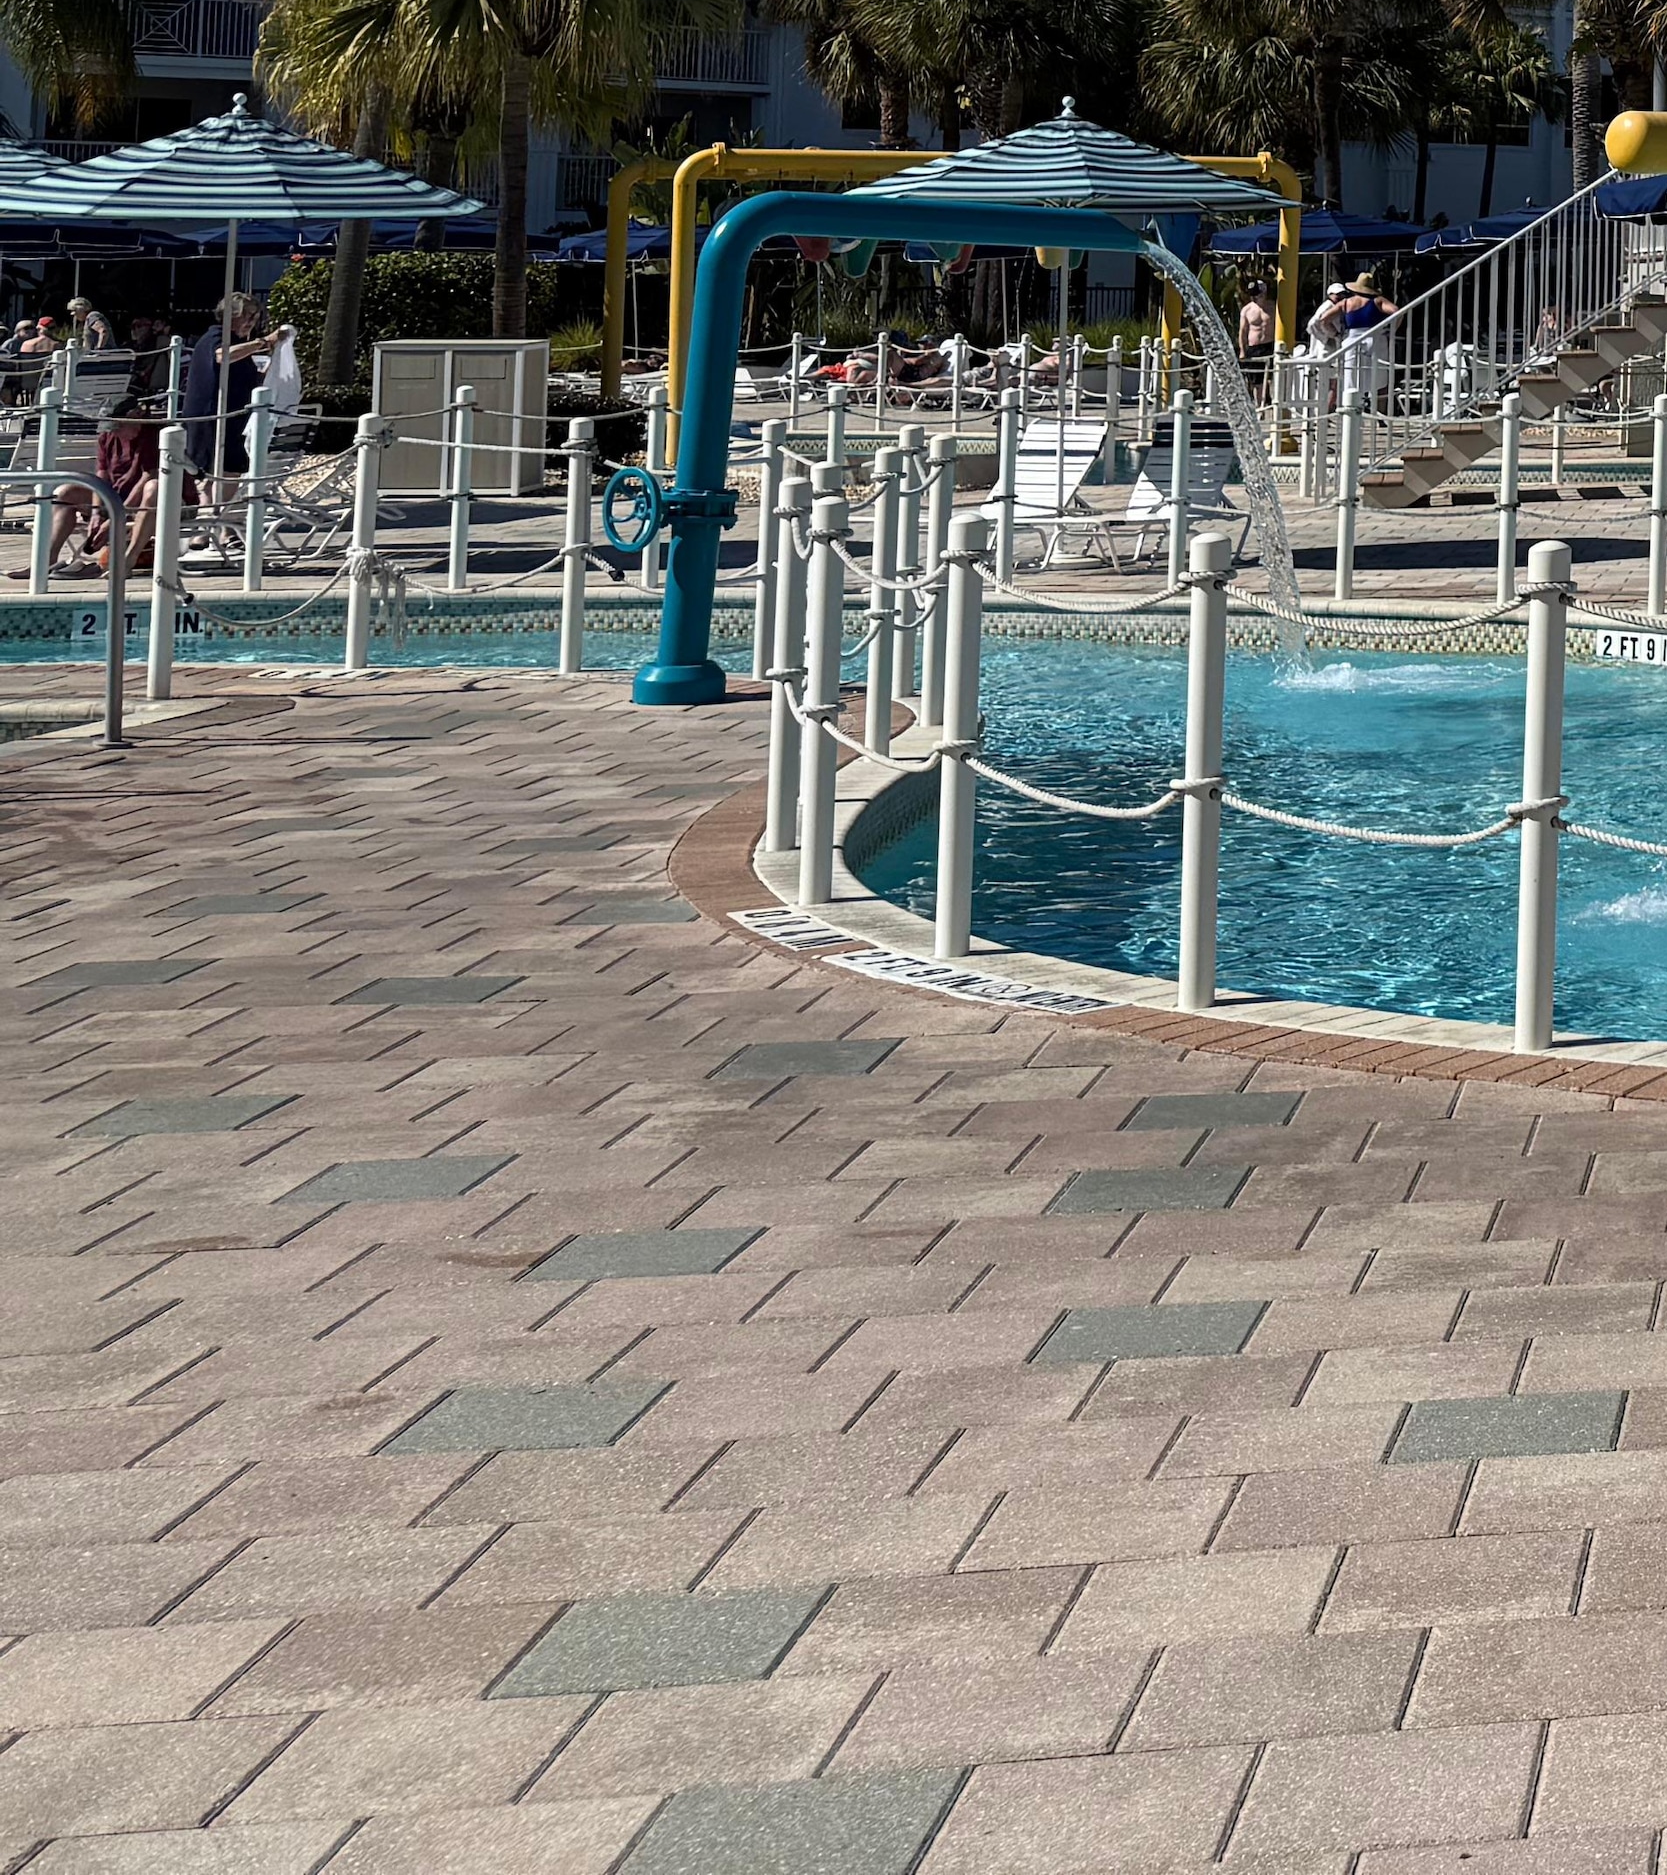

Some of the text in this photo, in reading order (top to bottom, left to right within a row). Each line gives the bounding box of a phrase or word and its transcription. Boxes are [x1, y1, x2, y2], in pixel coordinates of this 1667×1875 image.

[81, 613, 96, 635] 2
[1603, 635, 1613, 657] 2
[1646, 638, 1656, 661] 9
